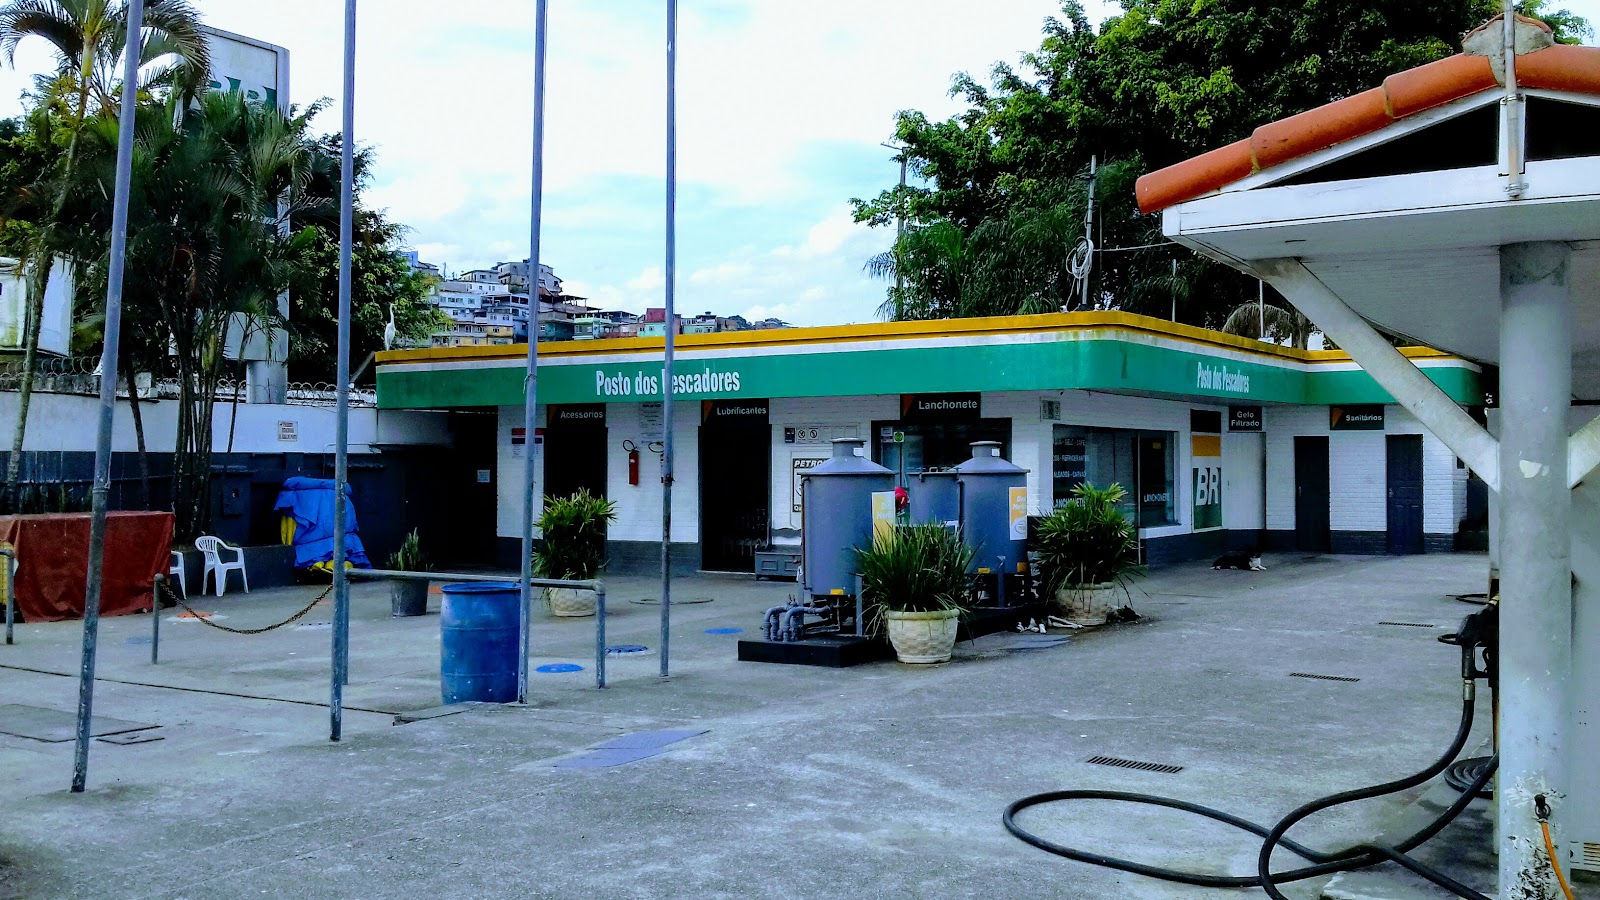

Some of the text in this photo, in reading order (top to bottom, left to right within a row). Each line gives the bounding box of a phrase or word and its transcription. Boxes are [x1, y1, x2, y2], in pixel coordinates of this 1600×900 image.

[596, 370, 631, 396] Posto
[635, 370, 658, 395] dos
[1197, 361, 1250, 393] Posto dos Pescadores
[716, 406, 767, 416] Lubrificantes
[918, 399, 978, 411] Lanchonete
[1236, 410, 1255, 419] Gelo
[1230, 419, 1260, 428] Filtrado
[1195, 467, 1220, 506] BR
